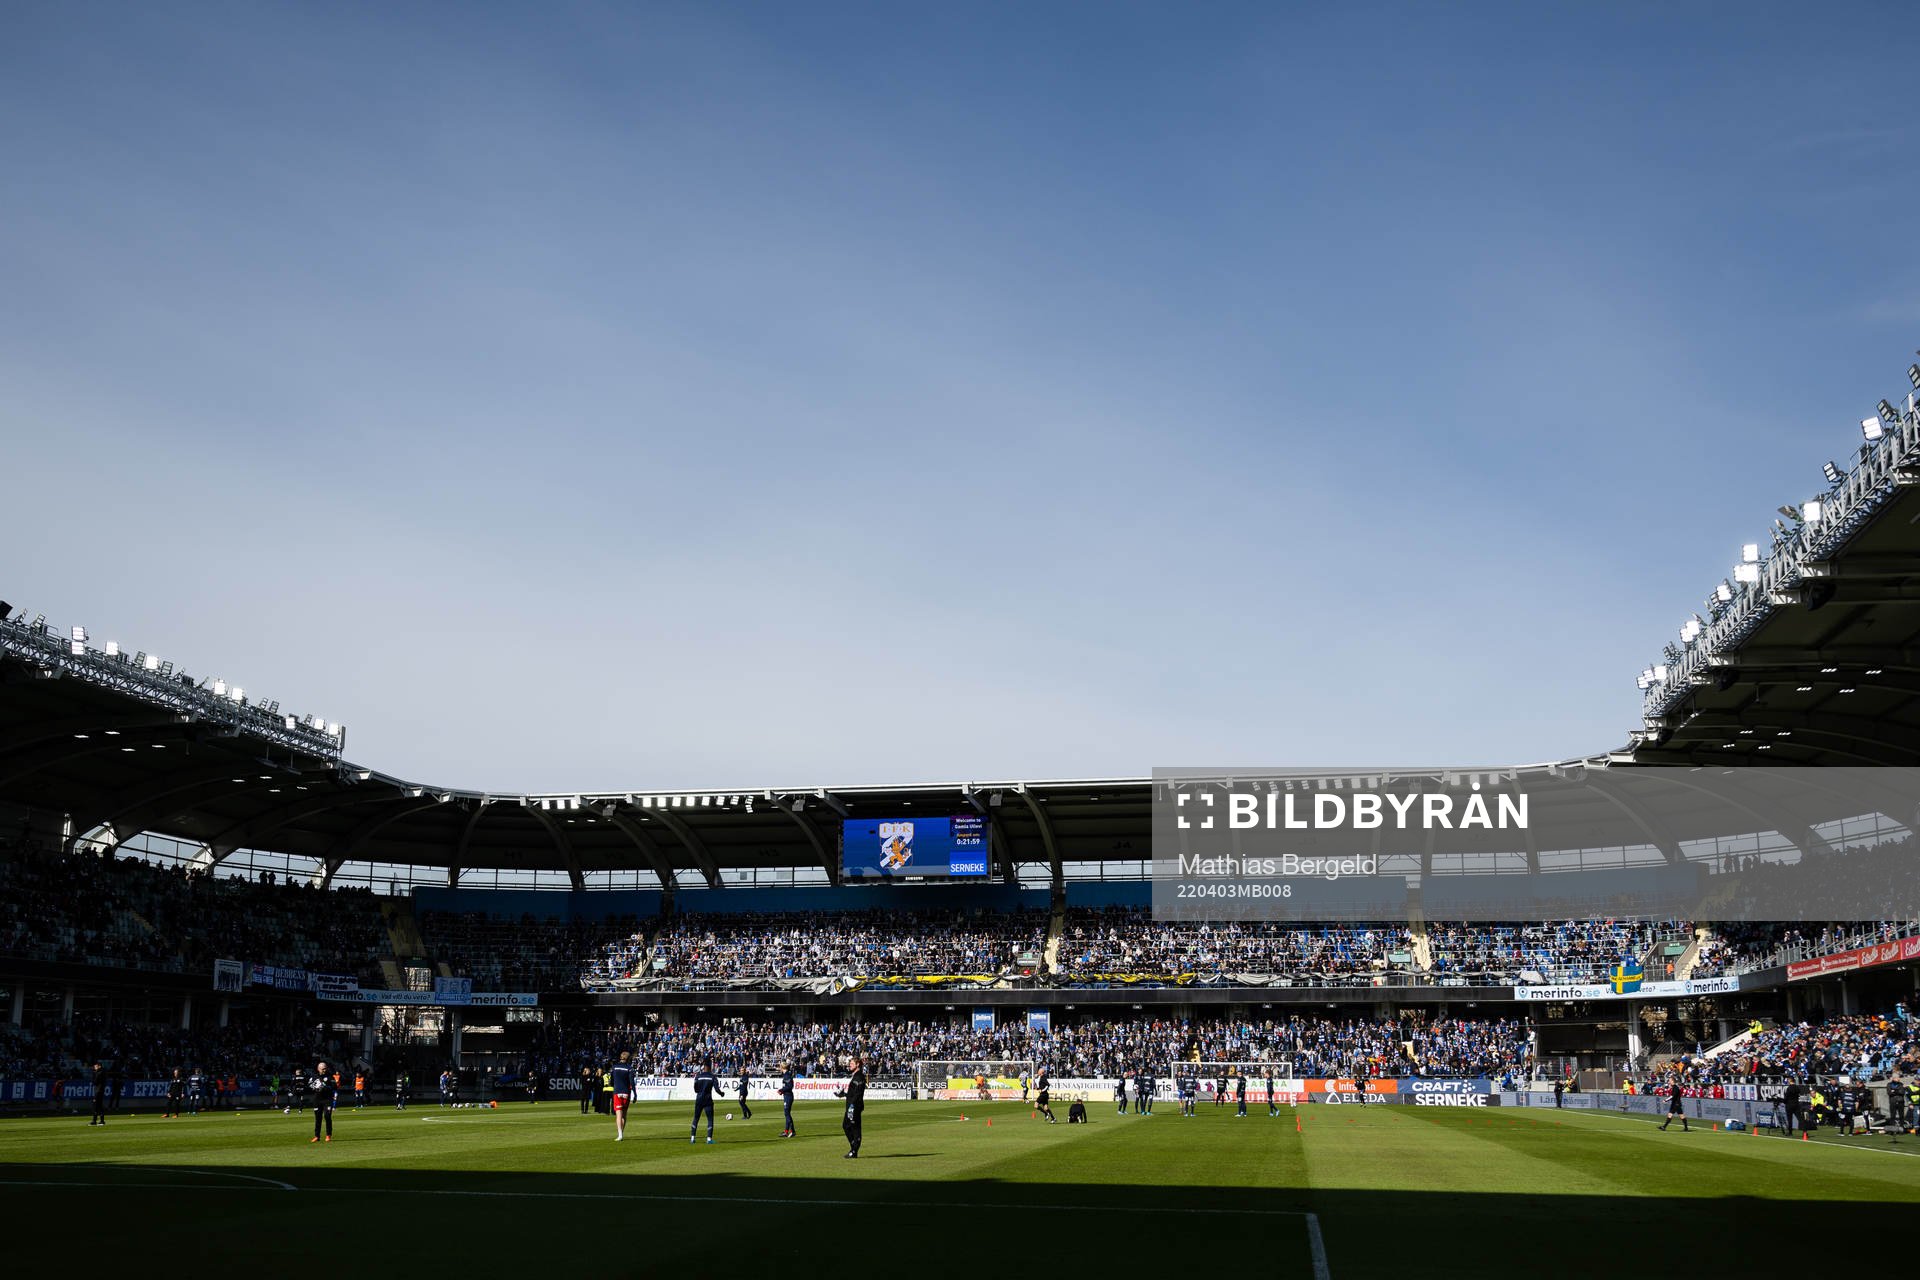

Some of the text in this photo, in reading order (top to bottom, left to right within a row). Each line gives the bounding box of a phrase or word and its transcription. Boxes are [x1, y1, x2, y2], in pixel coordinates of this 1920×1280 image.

[950, 863, 984, 872] SERNEKE
[1531, 987, 1600, 998] merinfo.se
[470, 994, 534, 1005] merinfo.se
[1411, 1082, 1462, 1092] CRAFT
[1415, 1094, 1488, 1107] SERNEKE
